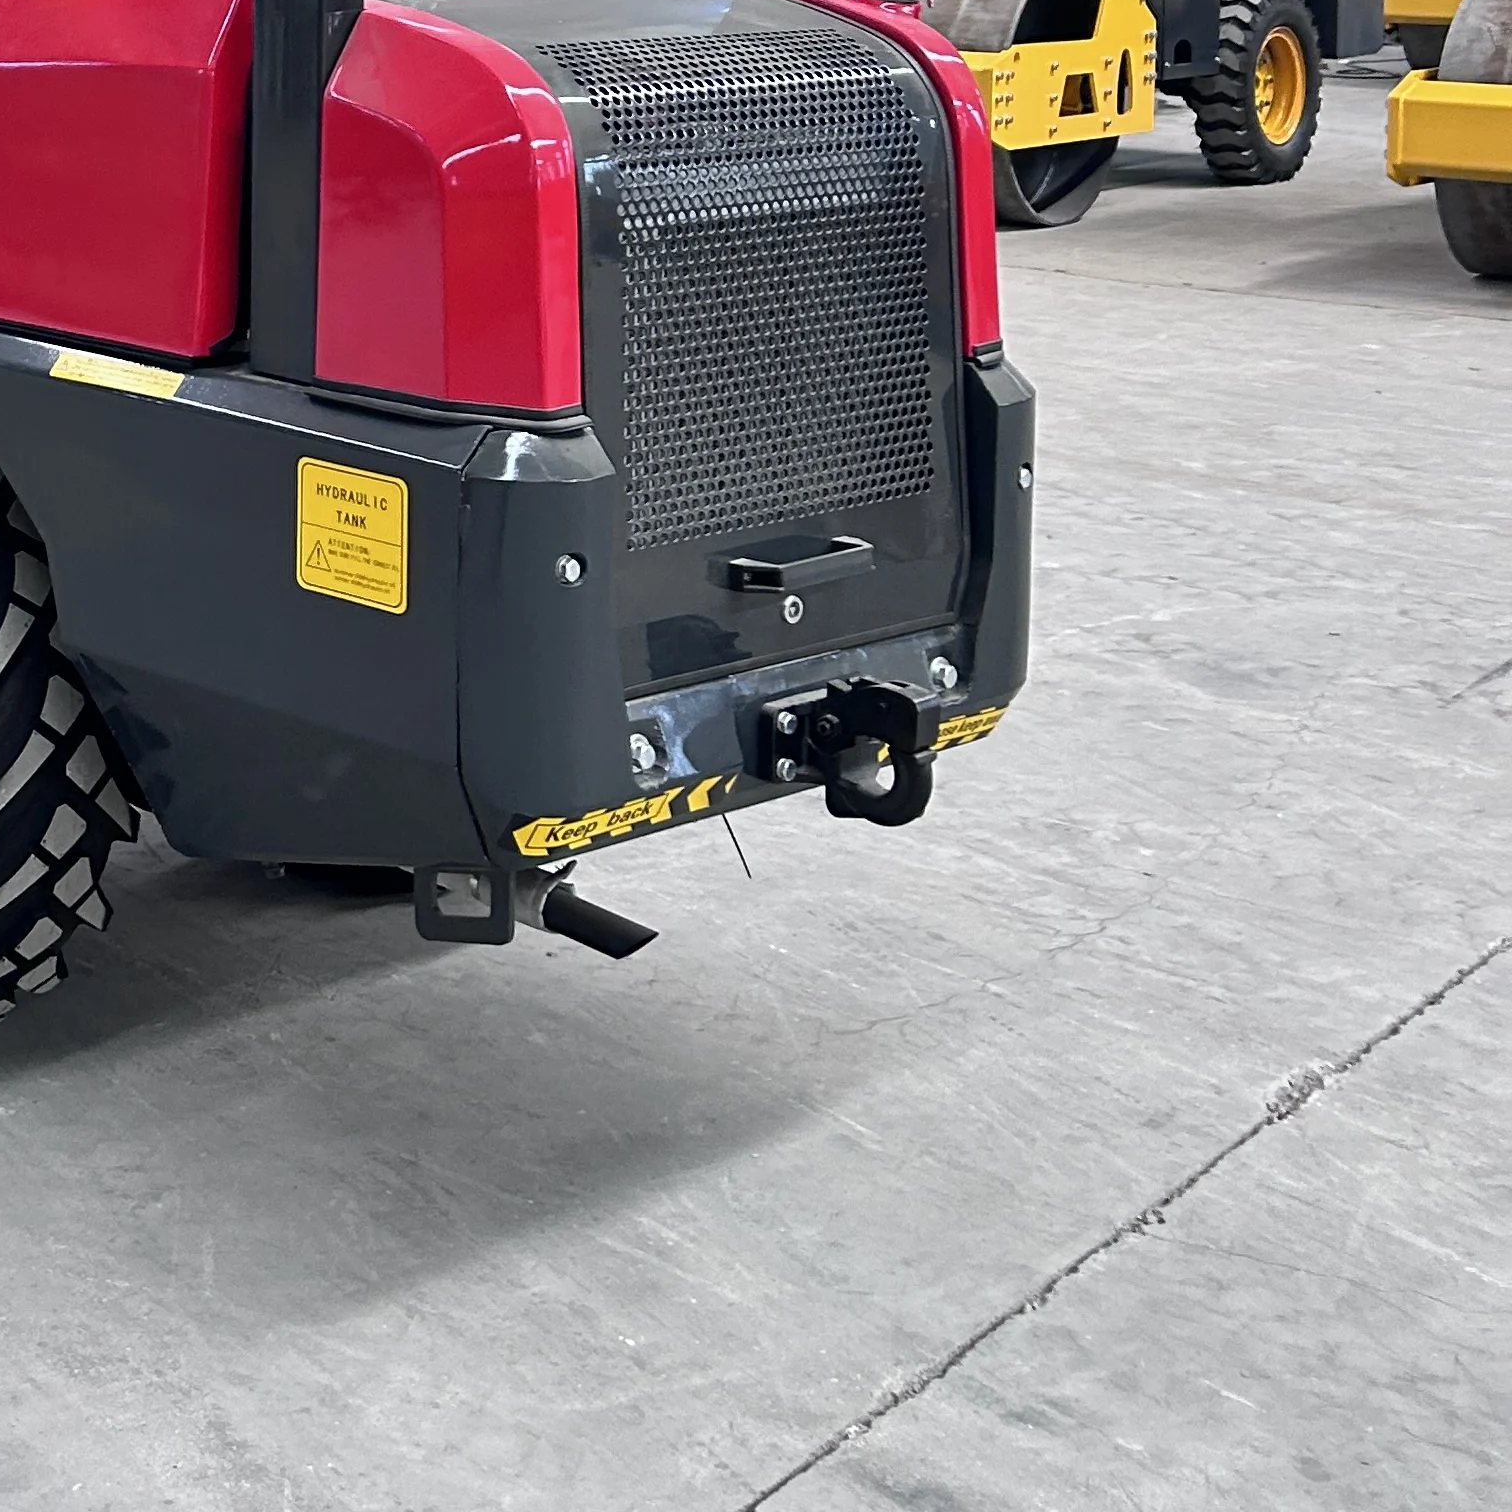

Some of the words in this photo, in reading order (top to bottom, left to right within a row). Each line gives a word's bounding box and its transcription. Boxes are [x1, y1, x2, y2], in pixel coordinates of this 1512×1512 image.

[316, 482, 388, 511] HYDRAULIC
[336, 510, 367, 530] TANK
[545, 821, 598, 843] Keep
[606, 801, 654, 827] back
